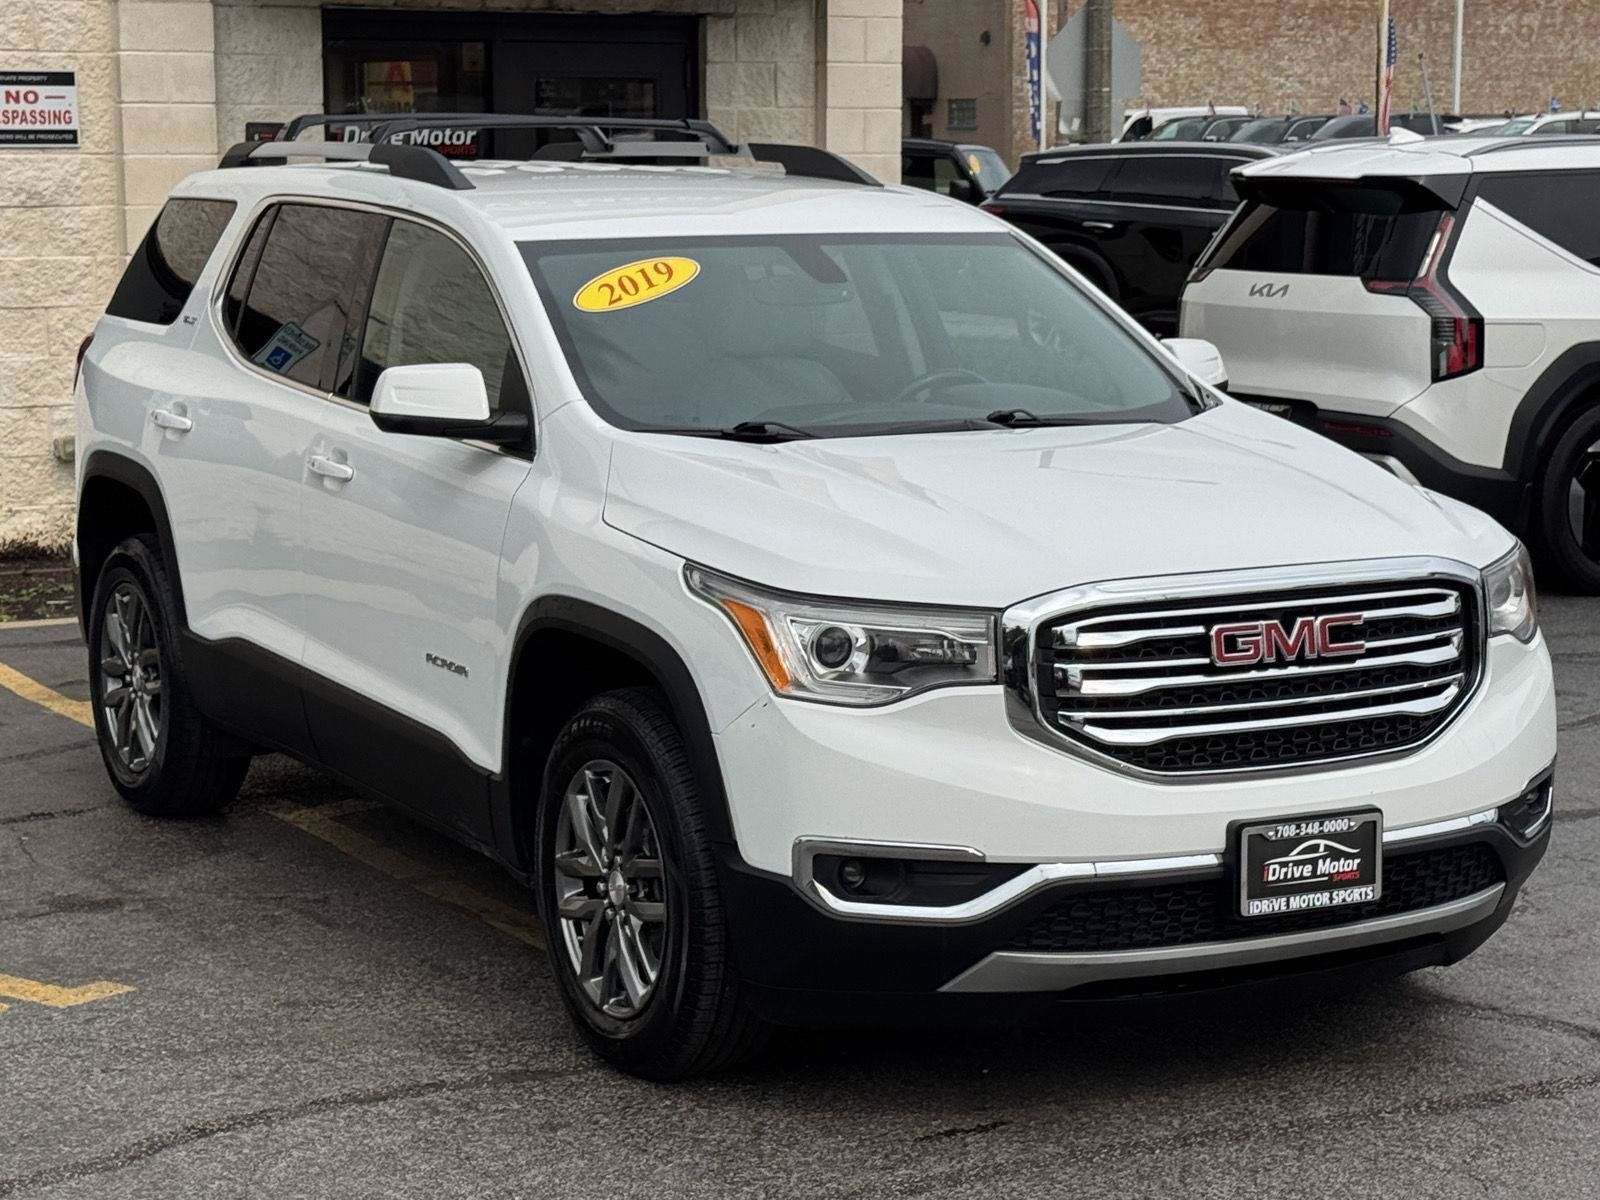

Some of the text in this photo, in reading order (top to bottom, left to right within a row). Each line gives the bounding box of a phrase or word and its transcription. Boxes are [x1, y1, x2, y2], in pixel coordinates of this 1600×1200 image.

[5, 90, 39, 104] NO
[0, 109, 72, 125] SPASSING
[597, 261, 674, 306] 2019
[1249, 282, 1290, 298] KIA
[1210, 613, 1367, 667] GMC
[1275, 818, 1349, 838] 708-348-0000
[1263, 857, 1361, 883] iDrive Motor
[1332, 870, 1361, 882] SPORTS
[1289, 893, 1330, 910] MOTOR
[1332, 886, 1374, 904] SPORTS
